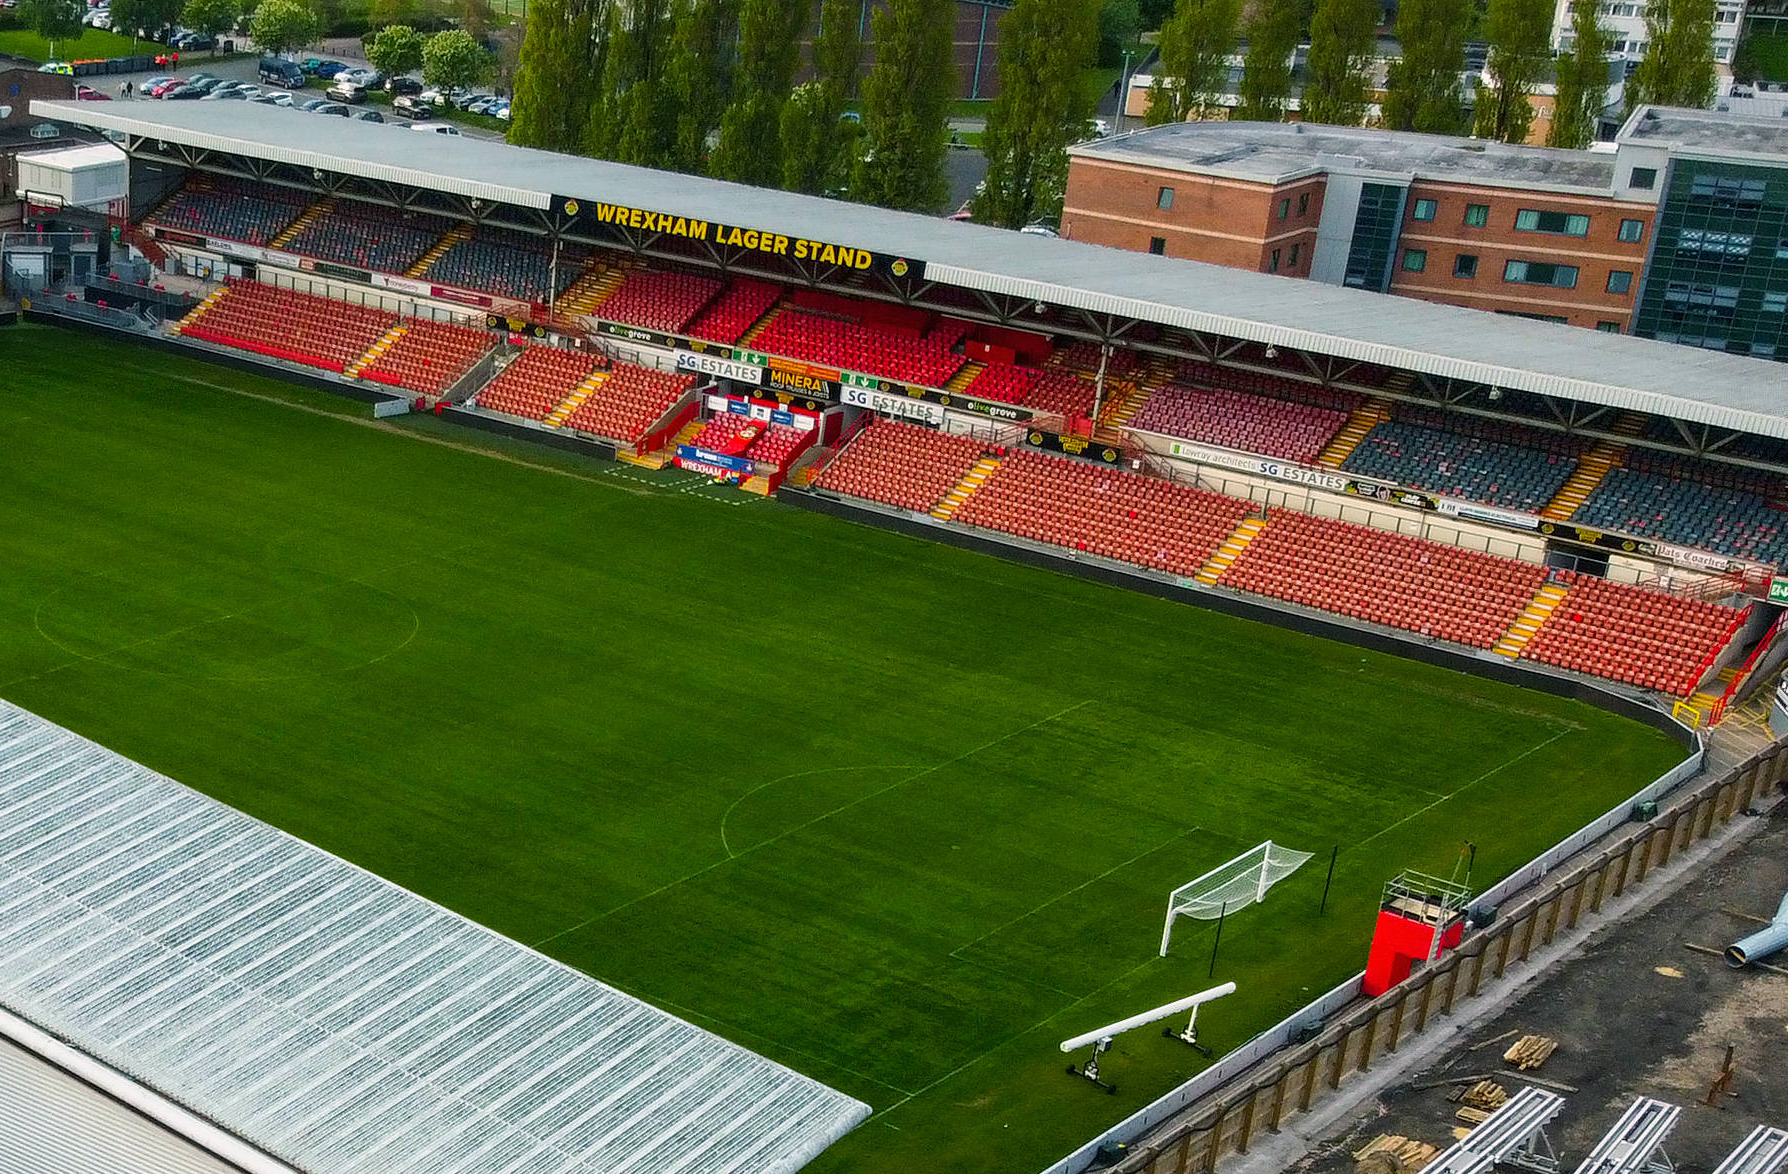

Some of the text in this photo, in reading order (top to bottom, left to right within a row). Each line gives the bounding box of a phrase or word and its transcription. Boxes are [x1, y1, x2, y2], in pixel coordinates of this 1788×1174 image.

[596, 203, 872, 270] WREXHAM LAGER STAND
[678, 354, 696, 368] SG
[701, 359, 757, 381] ESTATES
[771, 370, 822, 391] MINERA
[848, 390, 933, 418] SG ESTATES
[967, 402, 1017, 419] olivegrove
[1260, 463, 1278, 475] SG
[1283, 467, 1343, 489] ESTATES
